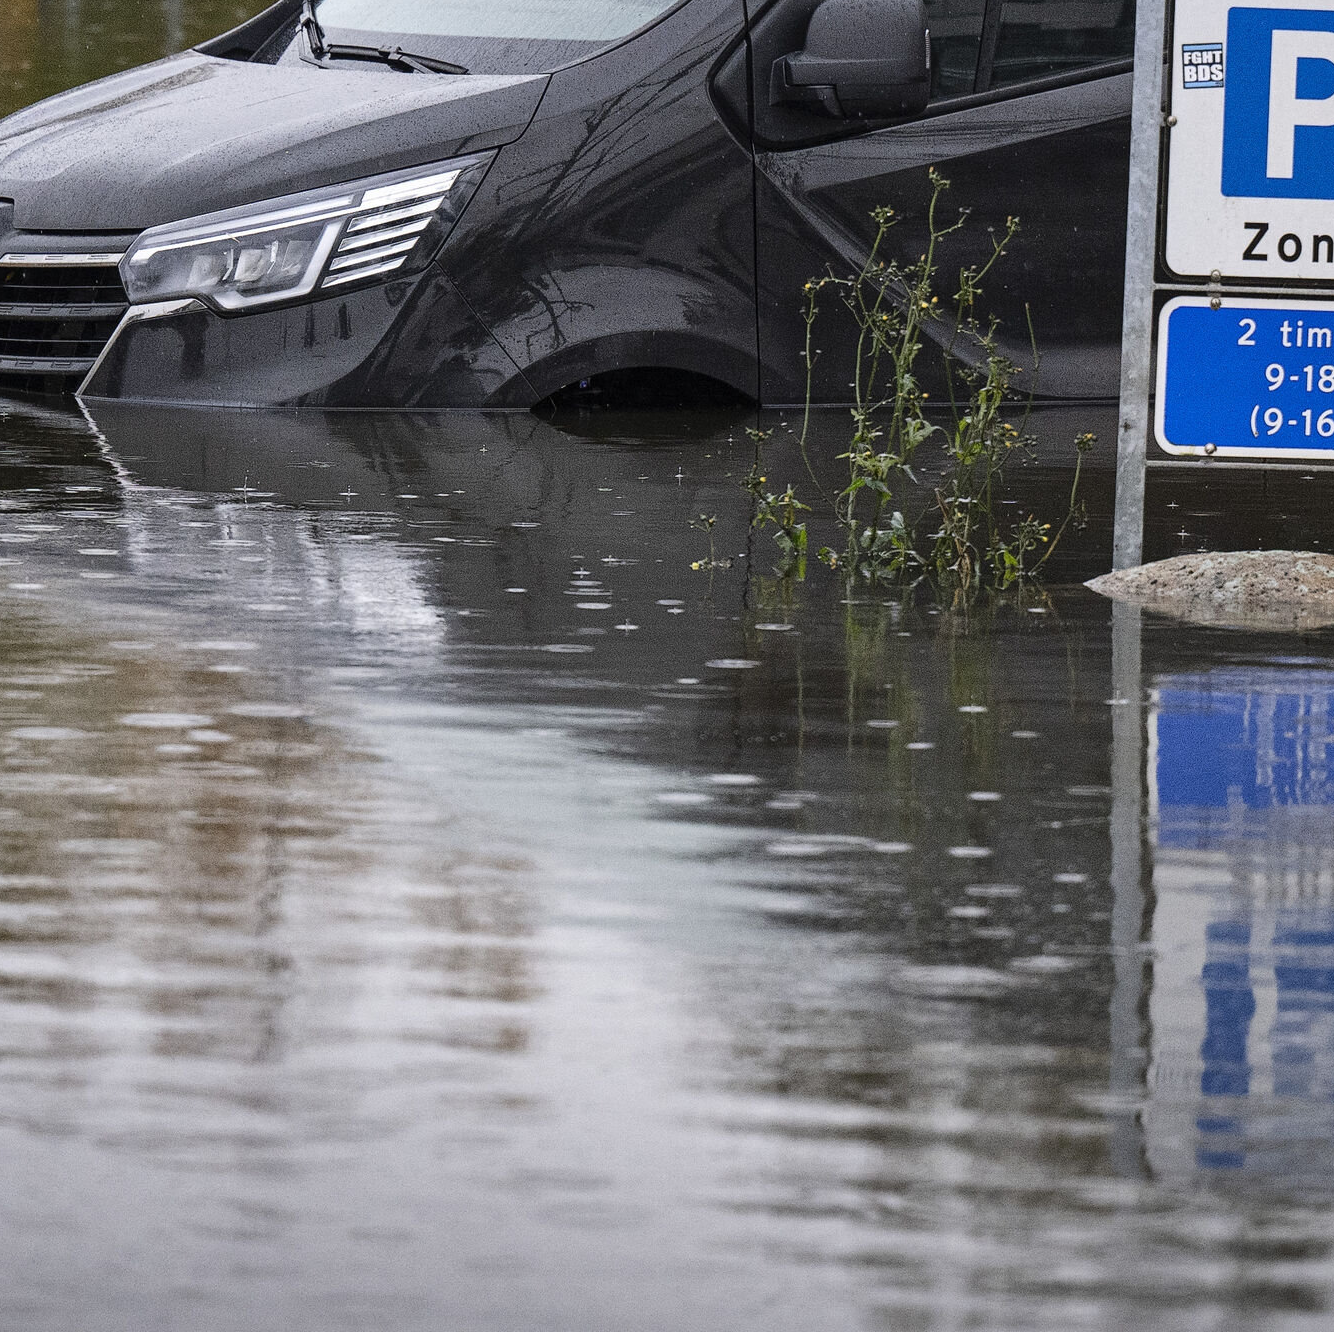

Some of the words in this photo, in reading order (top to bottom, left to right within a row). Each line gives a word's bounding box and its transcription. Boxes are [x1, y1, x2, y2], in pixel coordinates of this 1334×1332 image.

[1183, 50, 1223, 65] FGHT
[1183, 64, 1224, 82] BDS
[1237, 318, 1257, 347] 2
